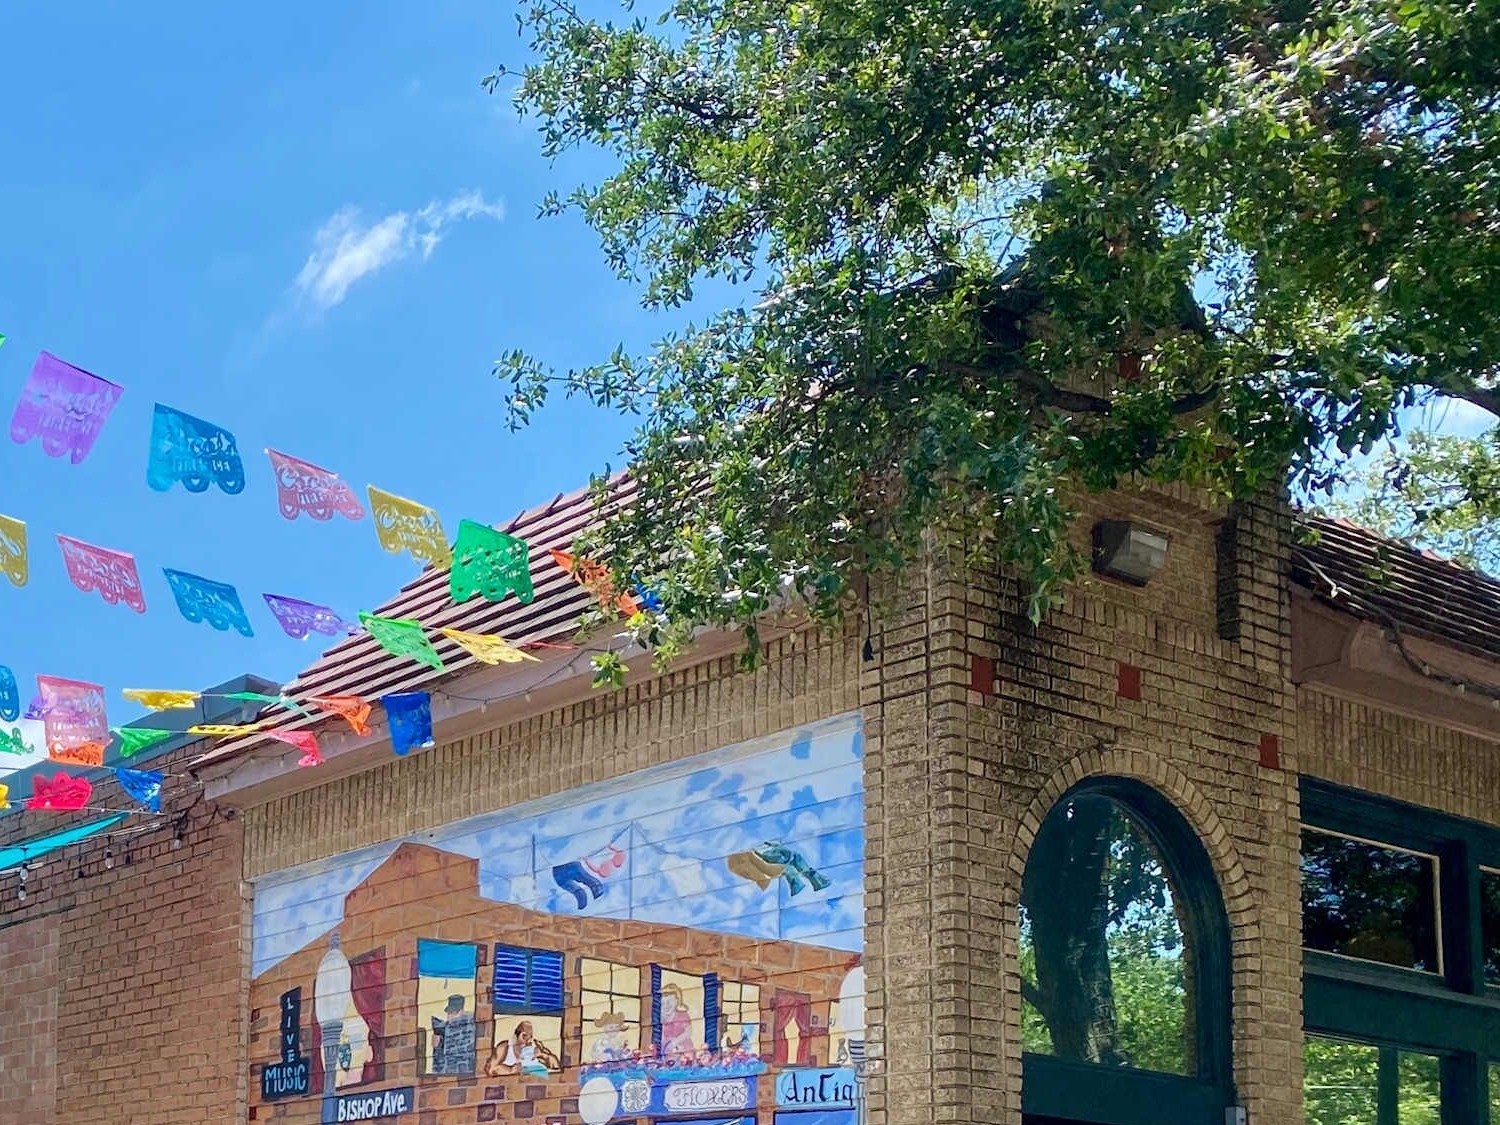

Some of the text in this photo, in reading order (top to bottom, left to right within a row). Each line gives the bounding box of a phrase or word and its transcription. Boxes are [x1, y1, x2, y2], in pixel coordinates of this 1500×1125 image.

[284, 996, 296, 1062] LIVE
[265, 1063, 306, 1095] MUSIC
[337, 1094, 381, 1121] BISHOP
